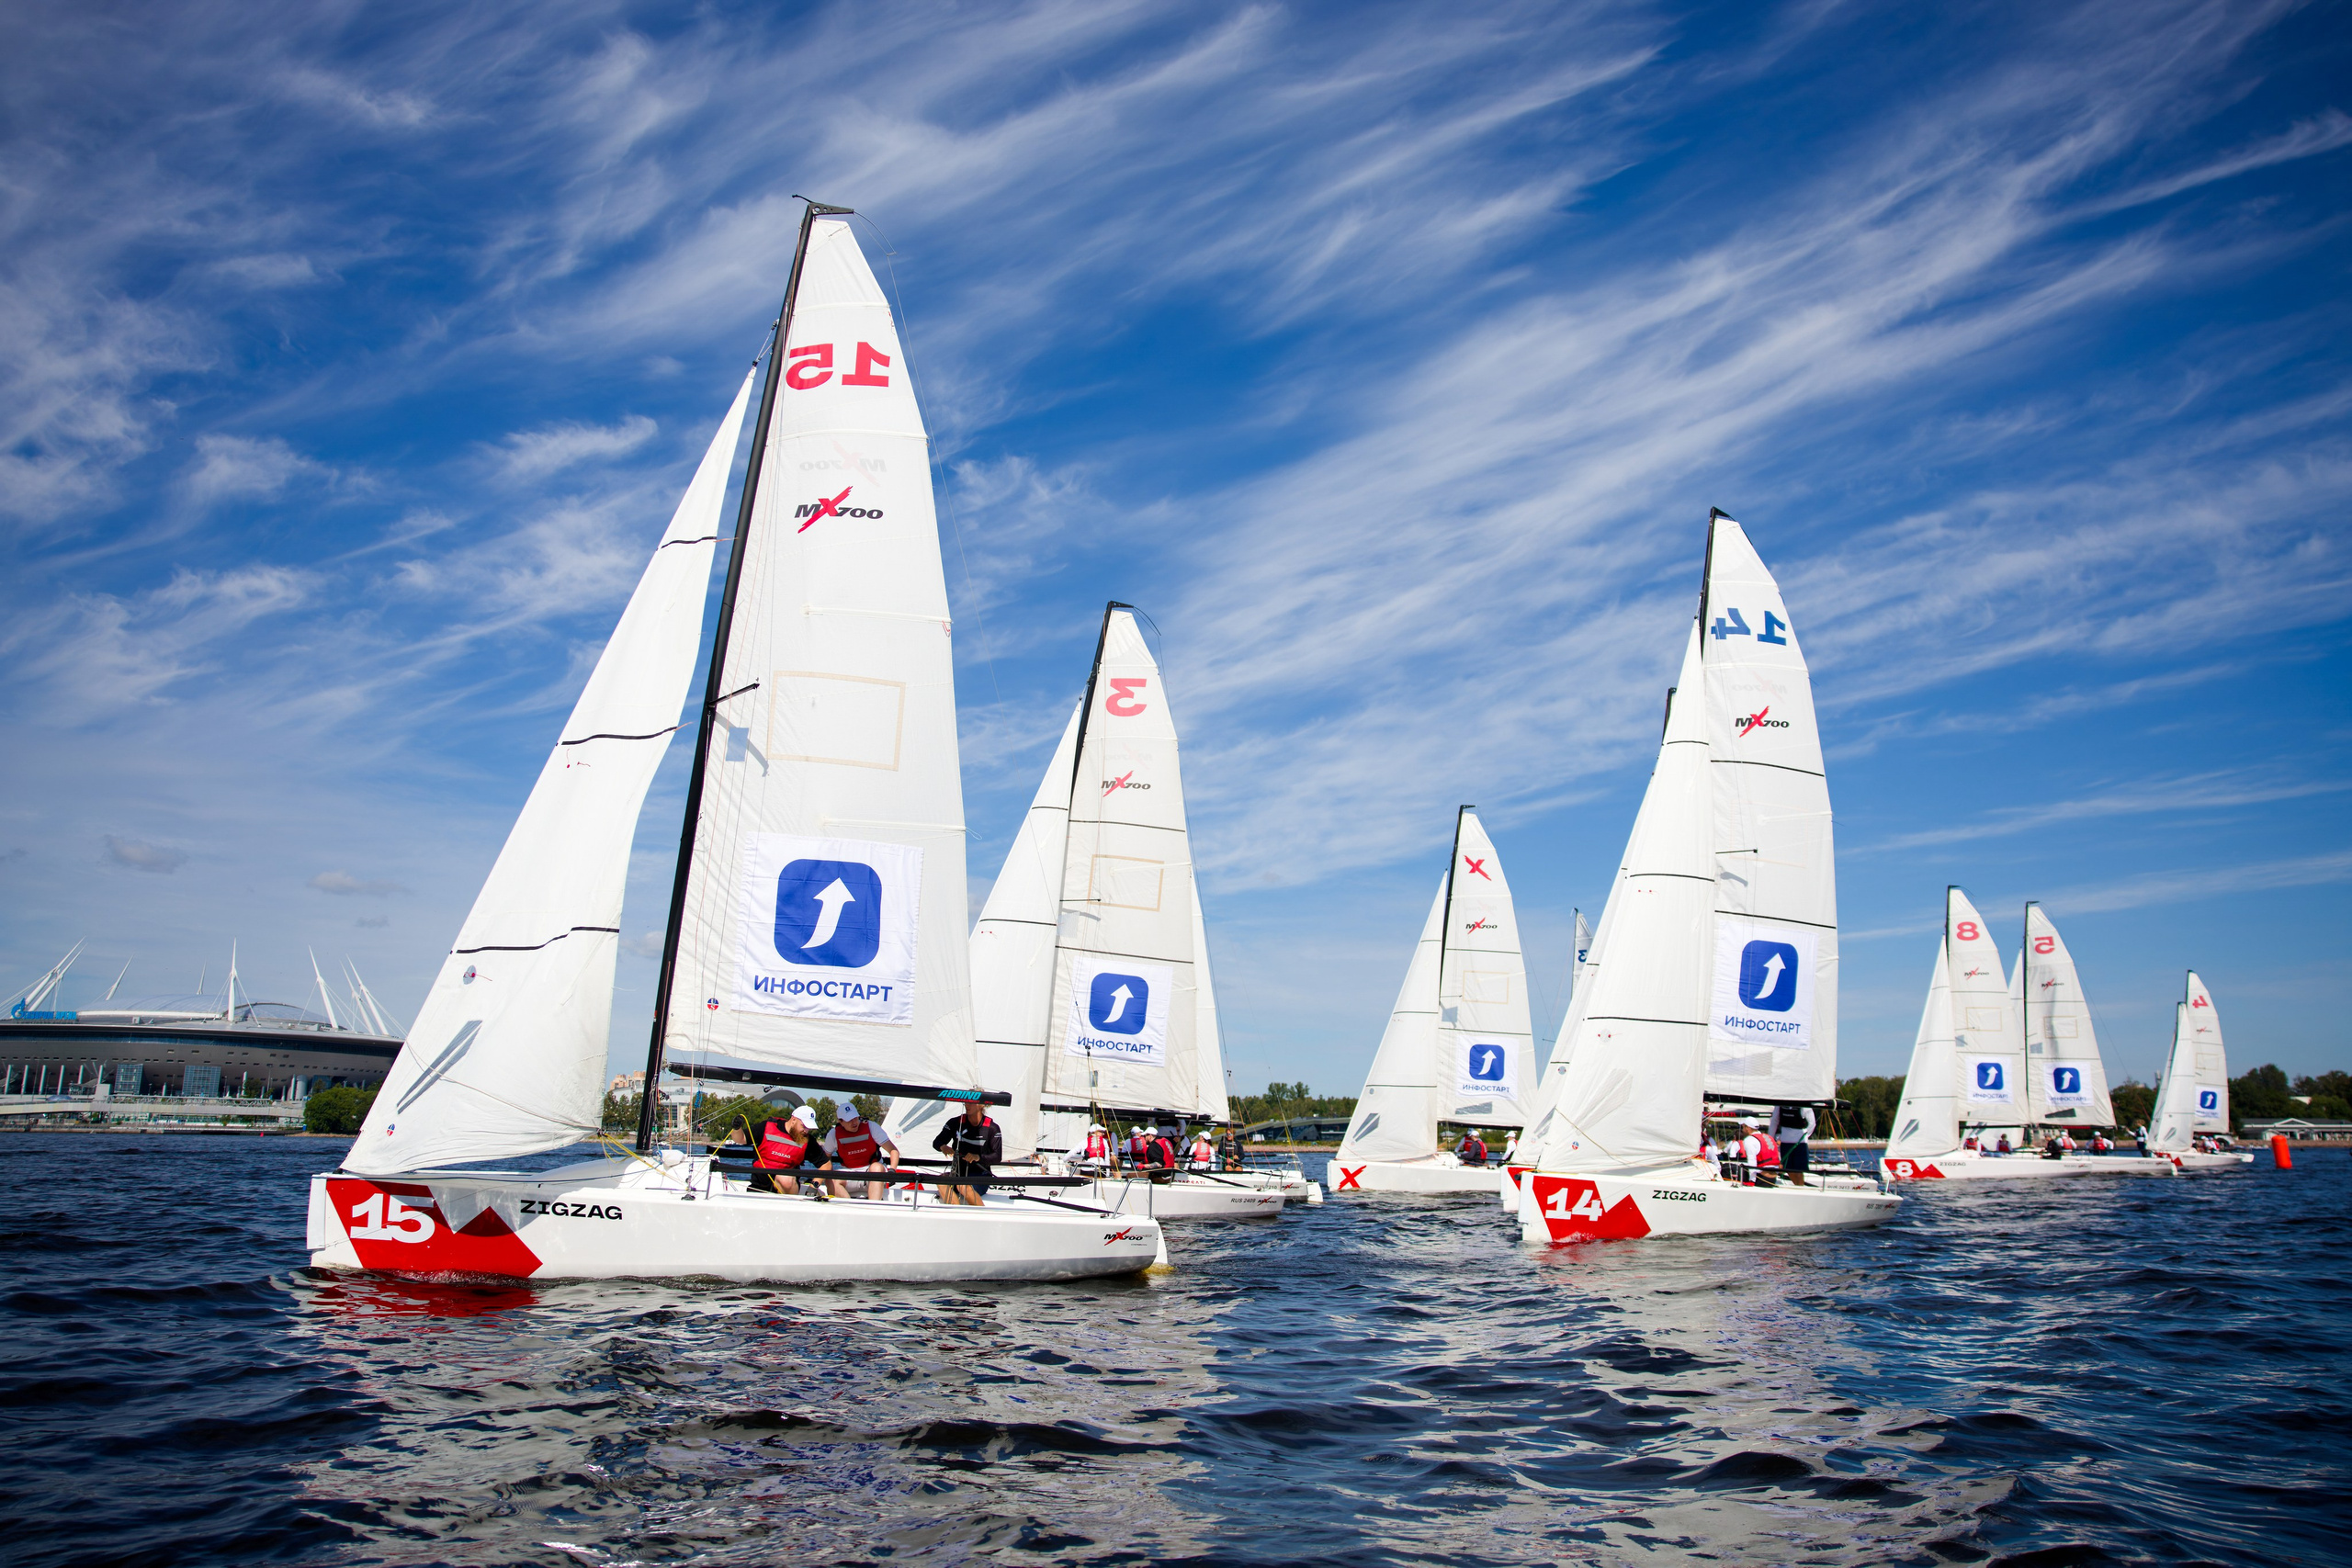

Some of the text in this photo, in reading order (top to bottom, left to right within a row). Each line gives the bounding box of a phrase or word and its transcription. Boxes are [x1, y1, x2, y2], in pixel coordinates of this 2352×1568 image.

[794, 485, 884, 534] MX700
[1735, 705, 1790, 738] MX700
[1101, 770, 1151, 797] MX700
[1464, 917, 1498, 935] MX700
[753, 975, 893, 1002] ИНФОСТАРТ
[1724, 1015, 1802, 1034] ИНФОСТАРТ
[1077, 1035, 1154, 1055] ИНФОСТАРТ
[937, 1089, 982, 1100] ADDINO
[1462, 1084, 1510, 1093] ИНФОСТАРТ
[771, 1150, 791, 1159] ZIGZAG
[1895, 1160, 1914, 1178] 8
[1544, 1187, 1603, 1222] 14
[1652, 1190, 1707, 1202] ZIGZAG
[349, 1192, 435, 1244] 15
[520, 1199, 623, 1221] ZIGZAG
[1103, 1226, 1144, 1247] MX700
